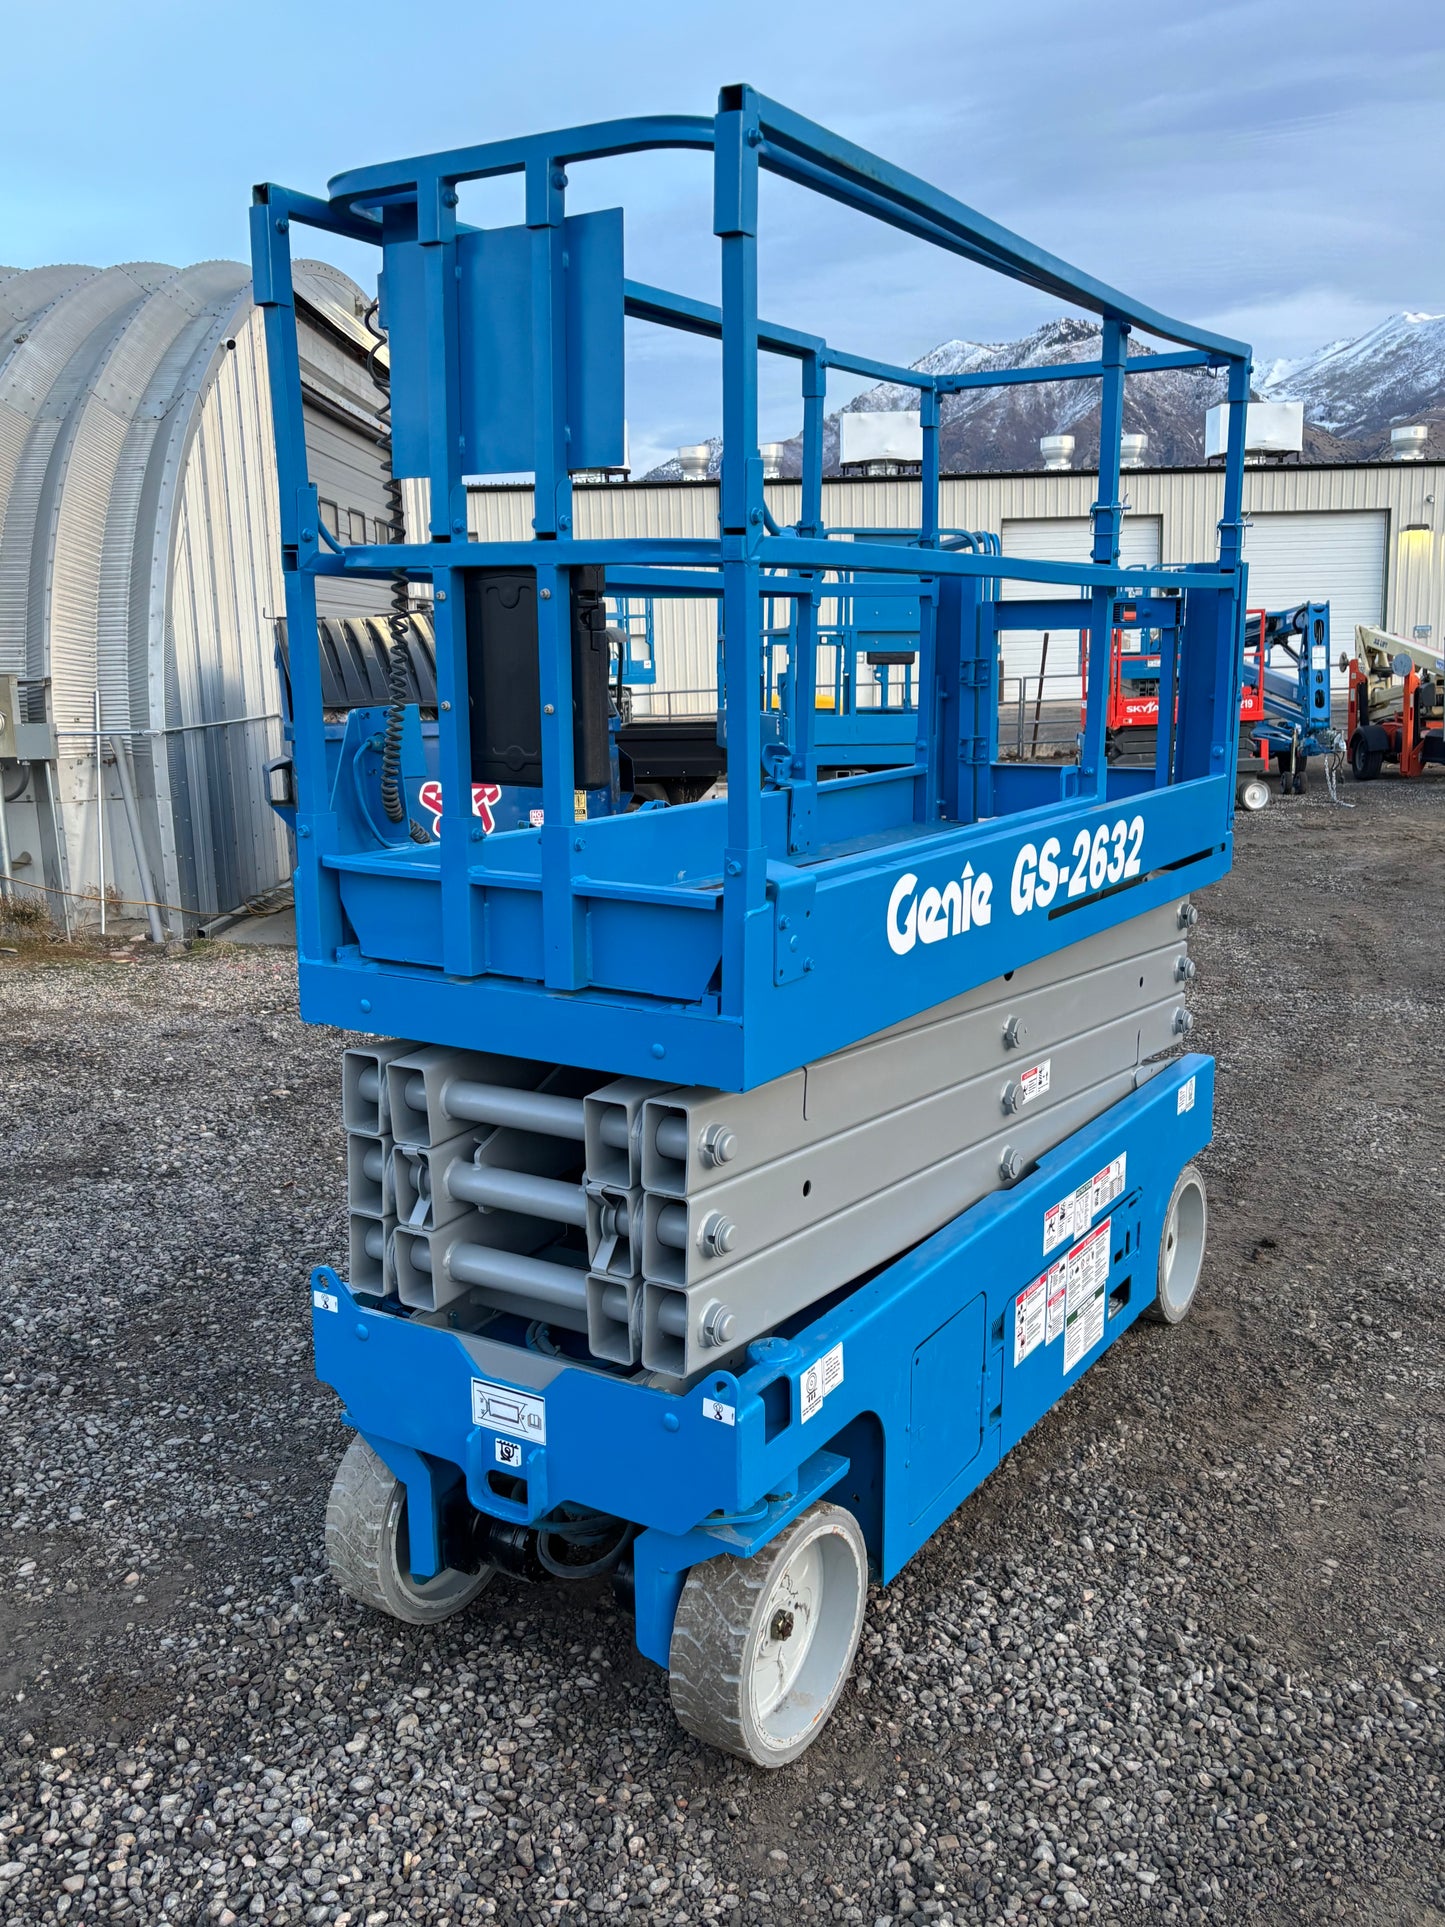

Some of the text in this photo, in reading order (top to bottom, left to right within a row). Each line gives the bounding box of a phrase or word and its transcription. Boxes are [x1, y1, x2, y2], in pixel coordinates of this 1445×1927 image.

[1126, 701, 1159, 714] SKYJA
[1240, 699, 1253, 709] 219
[886, 814, 1145, 956] Genie GS-2632
